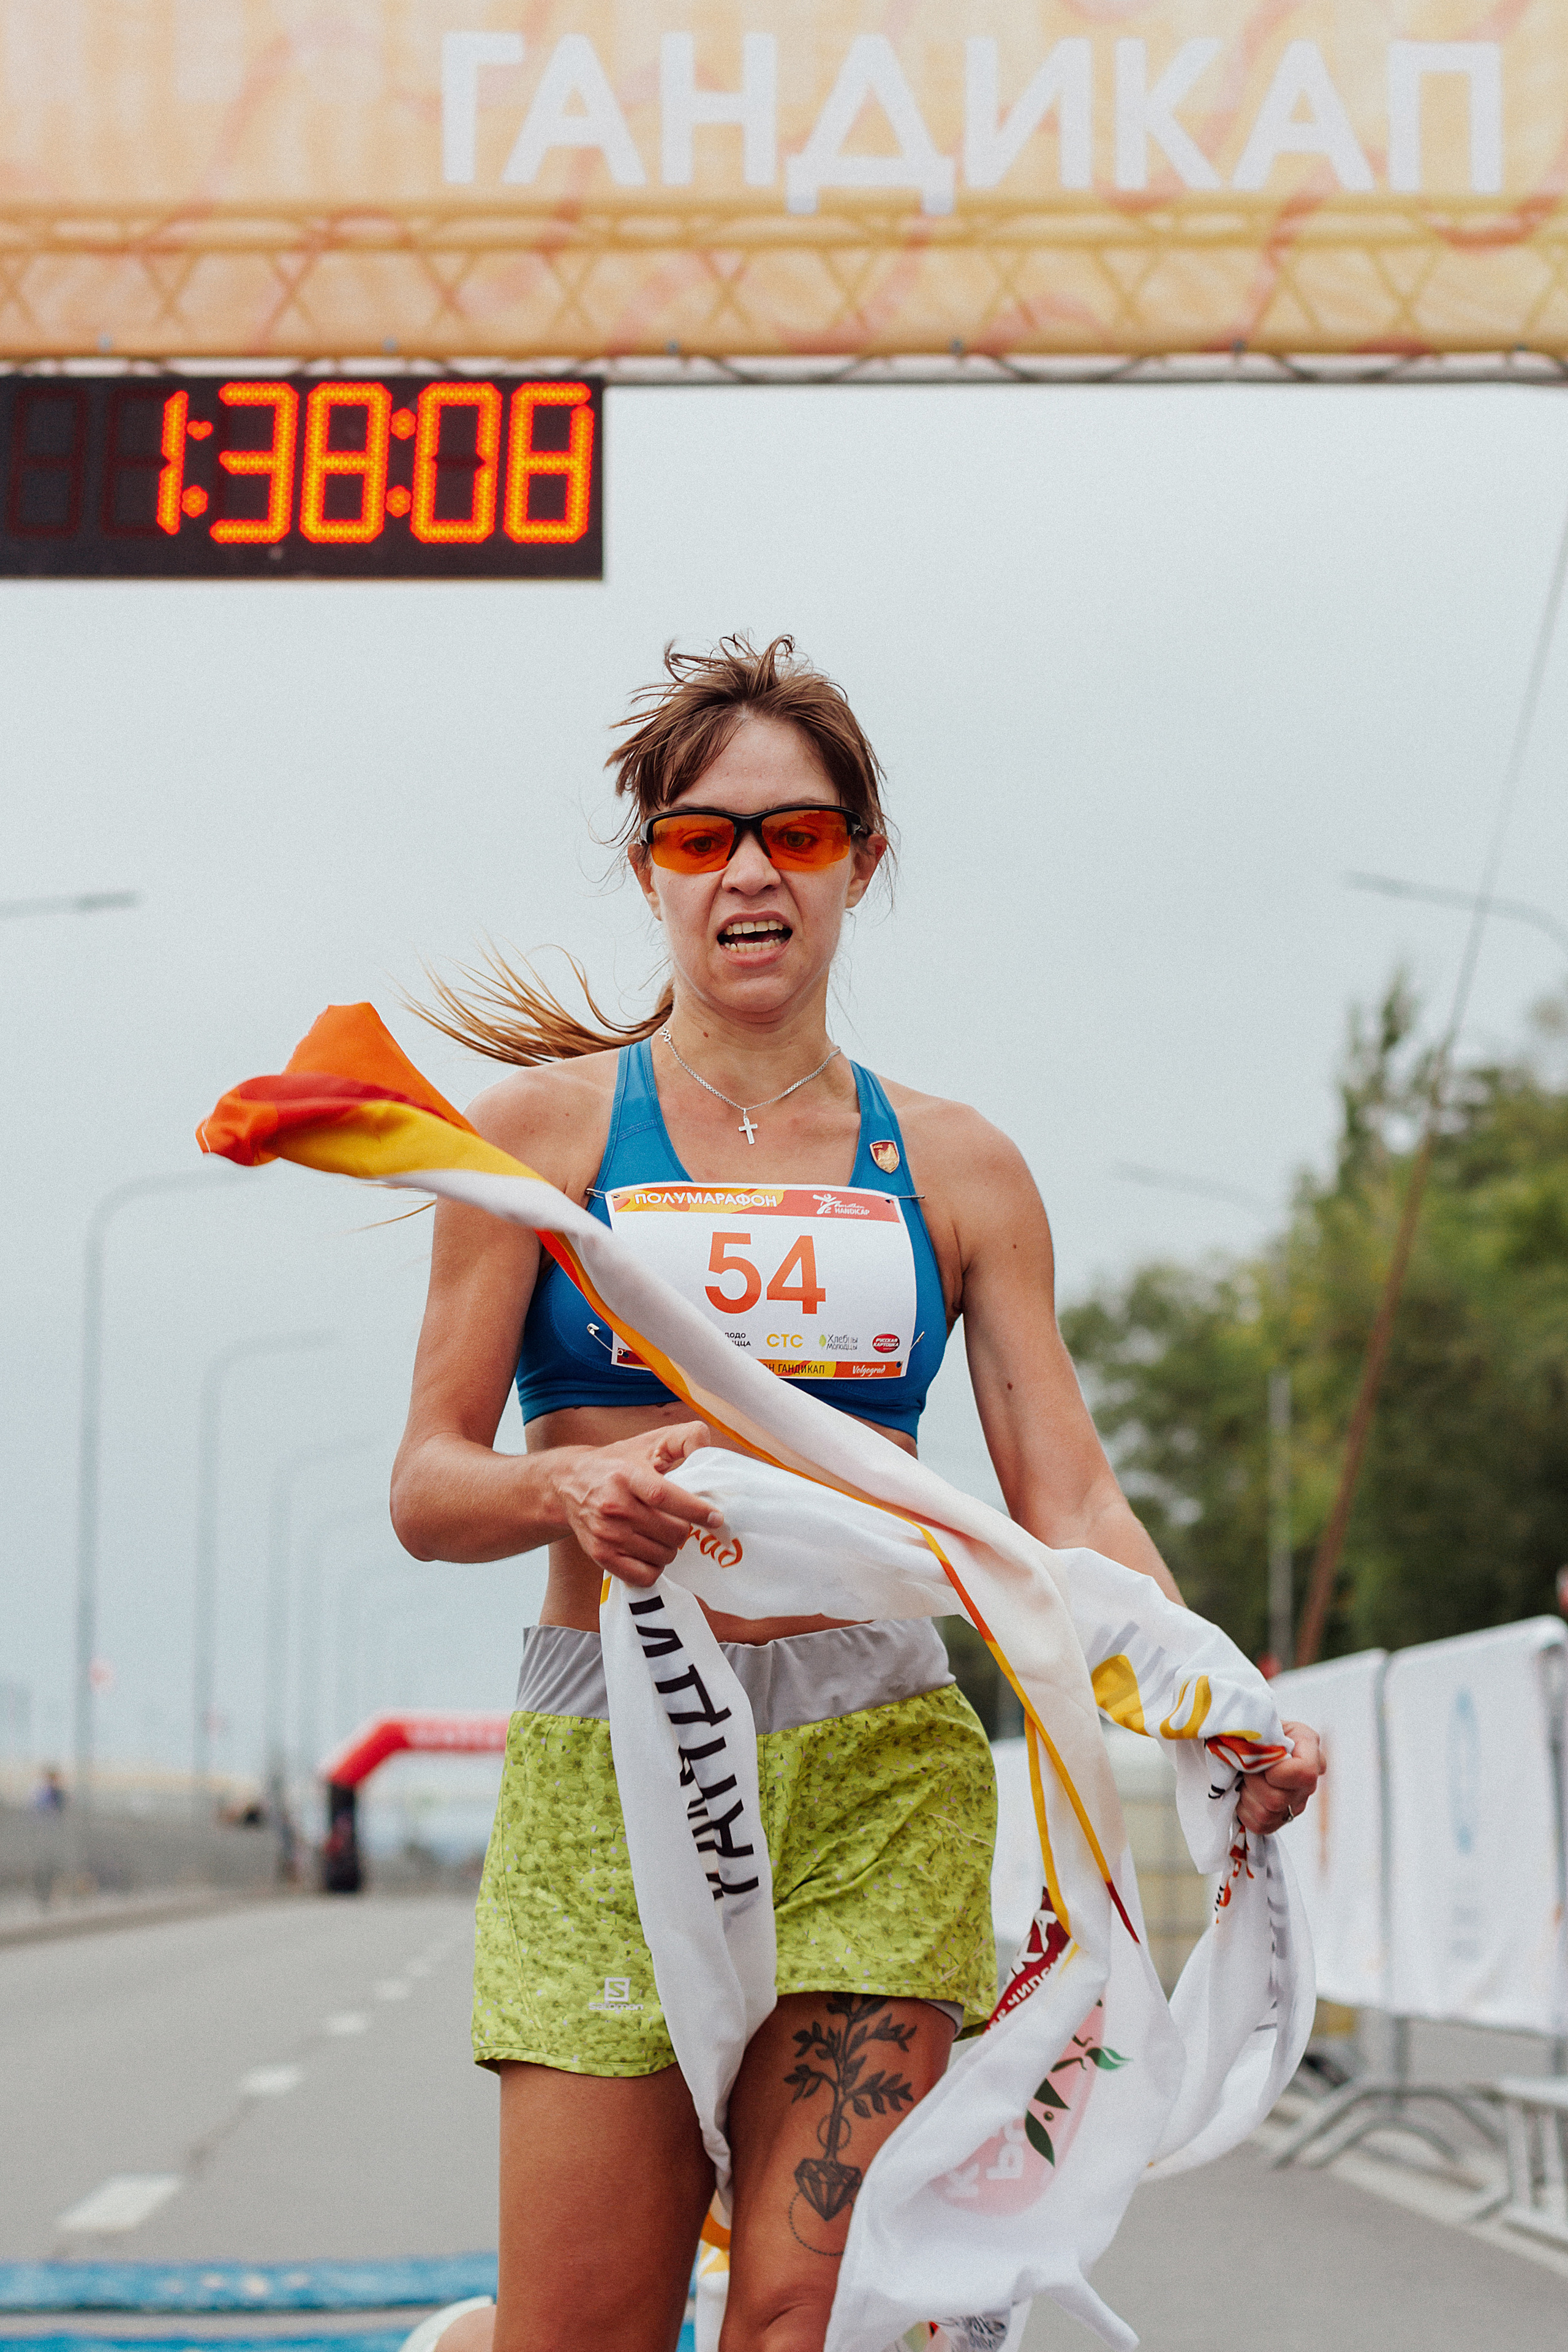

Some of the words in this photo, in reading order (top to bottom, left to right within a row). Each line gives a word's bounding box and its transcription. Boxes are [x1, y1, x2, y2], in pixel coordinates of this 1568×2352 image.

[442, 32, 1502, 214] ГАНДИКАП
[635, 1192, 777, 1207] ПОЛУМАРАФОН
[704, 1232, 826, 1314] 54
[766, 1333, 803, 1348] СТС
[778, 1363, 824, 1374] ГАНДИКАП
[852, 1364, 886, 1377] Volgograd
